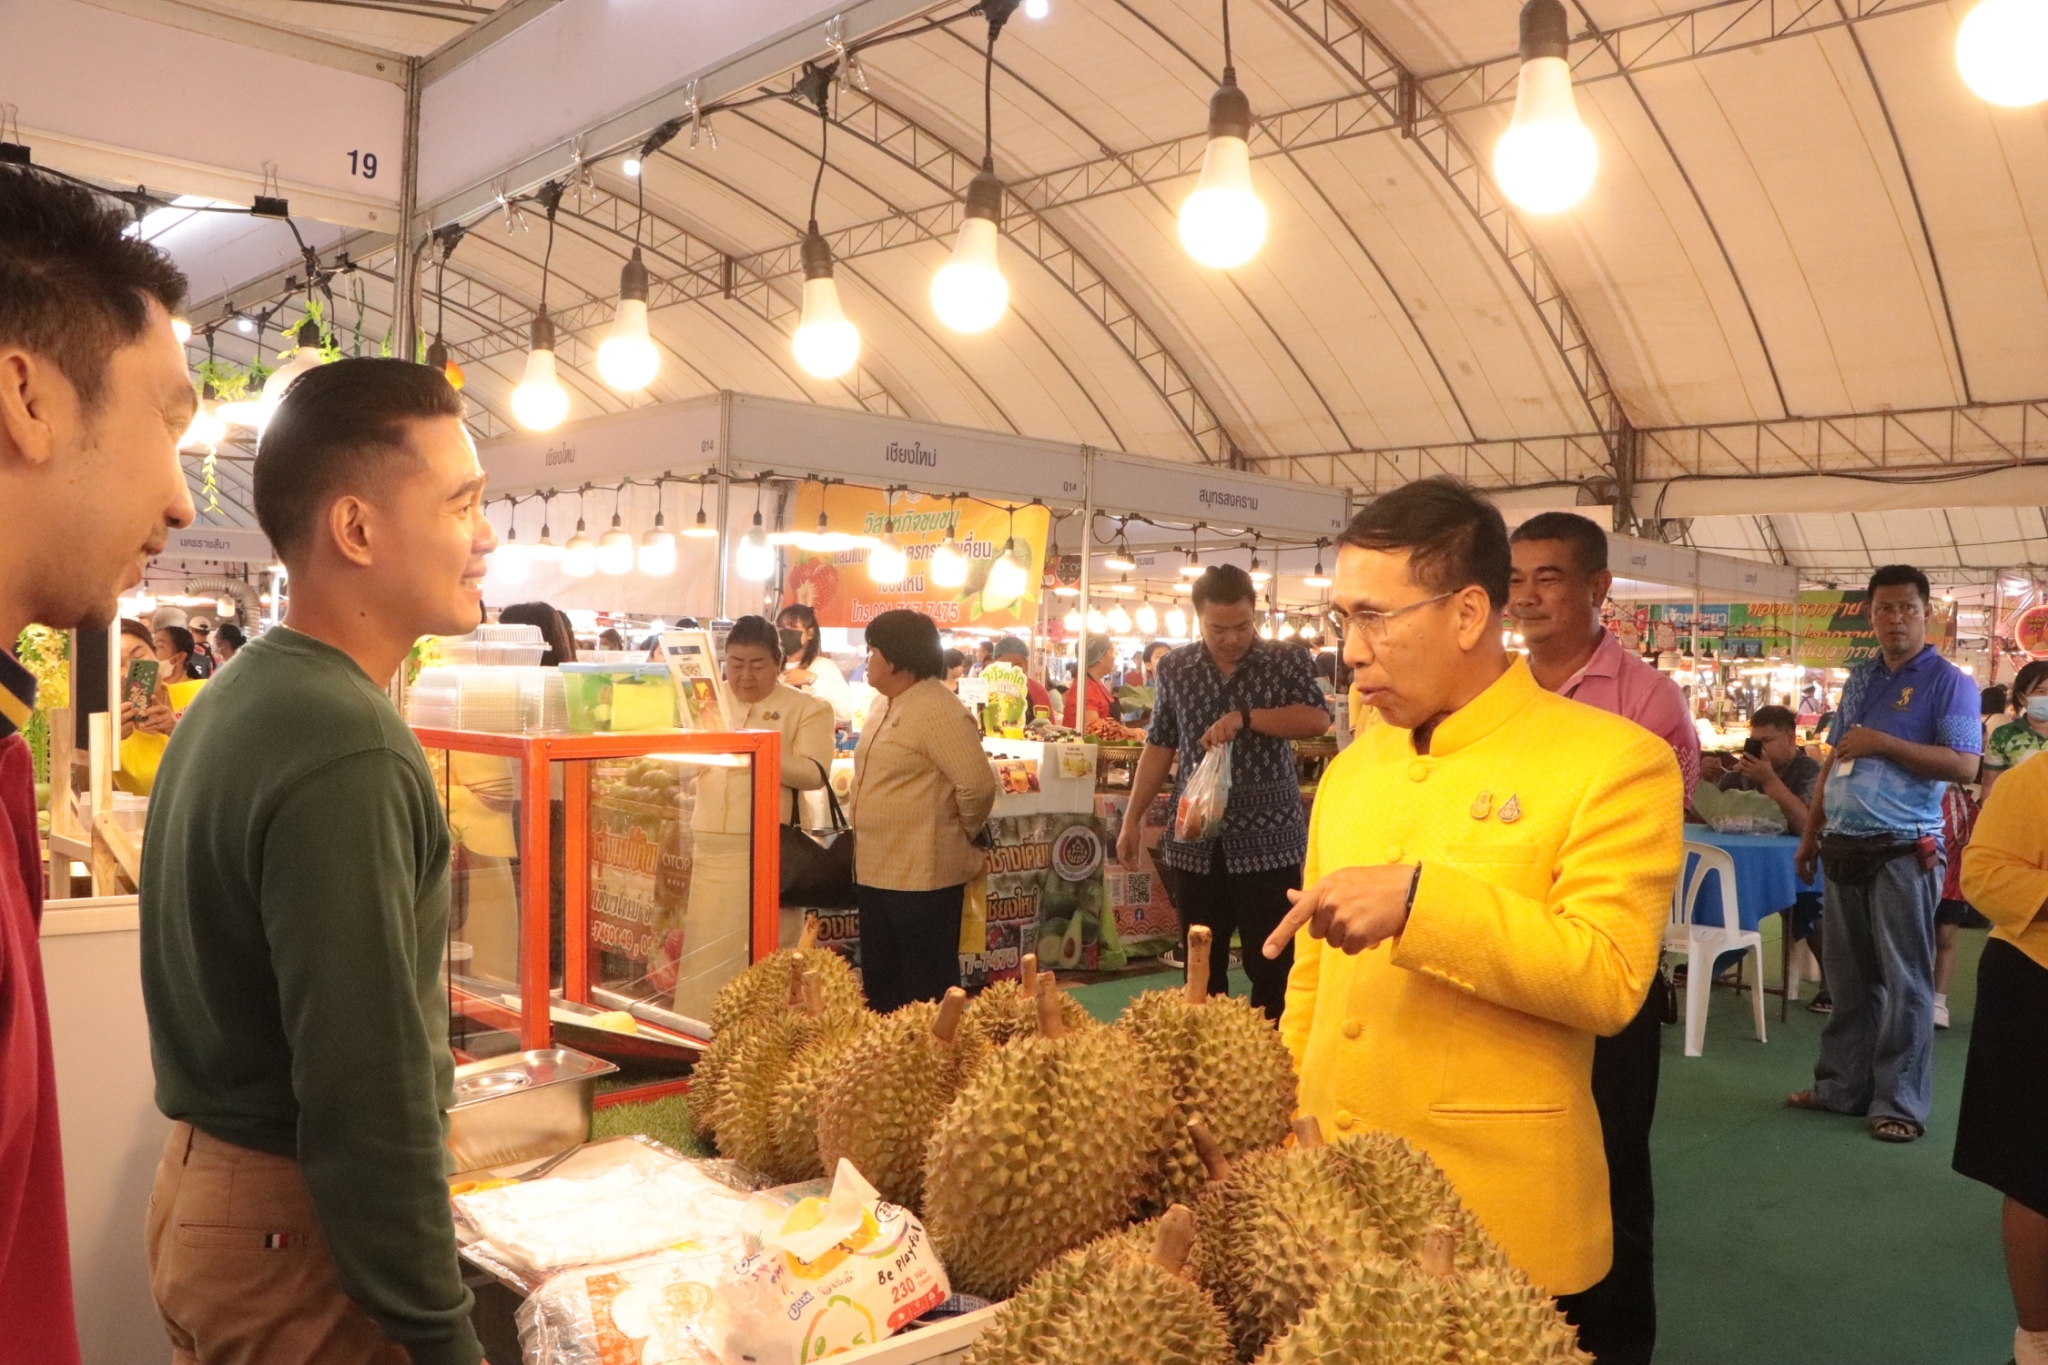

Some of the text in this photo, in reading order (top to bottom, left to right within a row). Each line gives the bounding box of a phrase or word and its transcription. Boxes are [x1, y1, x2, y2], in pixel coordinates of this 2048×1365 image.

[347, 149, 378, 180] 19
[545, 441, 576, 467] เชียงใหม่
[886, 442, 937, 468] เชียงใหม่
[1199, 489, 1259, 511] สมุทรสงคราม
[180, 538, 230, 550] นครราชสีมา
[662, 852, 691, 870] OTOP
[877, 1224, 922, 1285] Be Playful
[891, 1276, 916, 1304] 230
